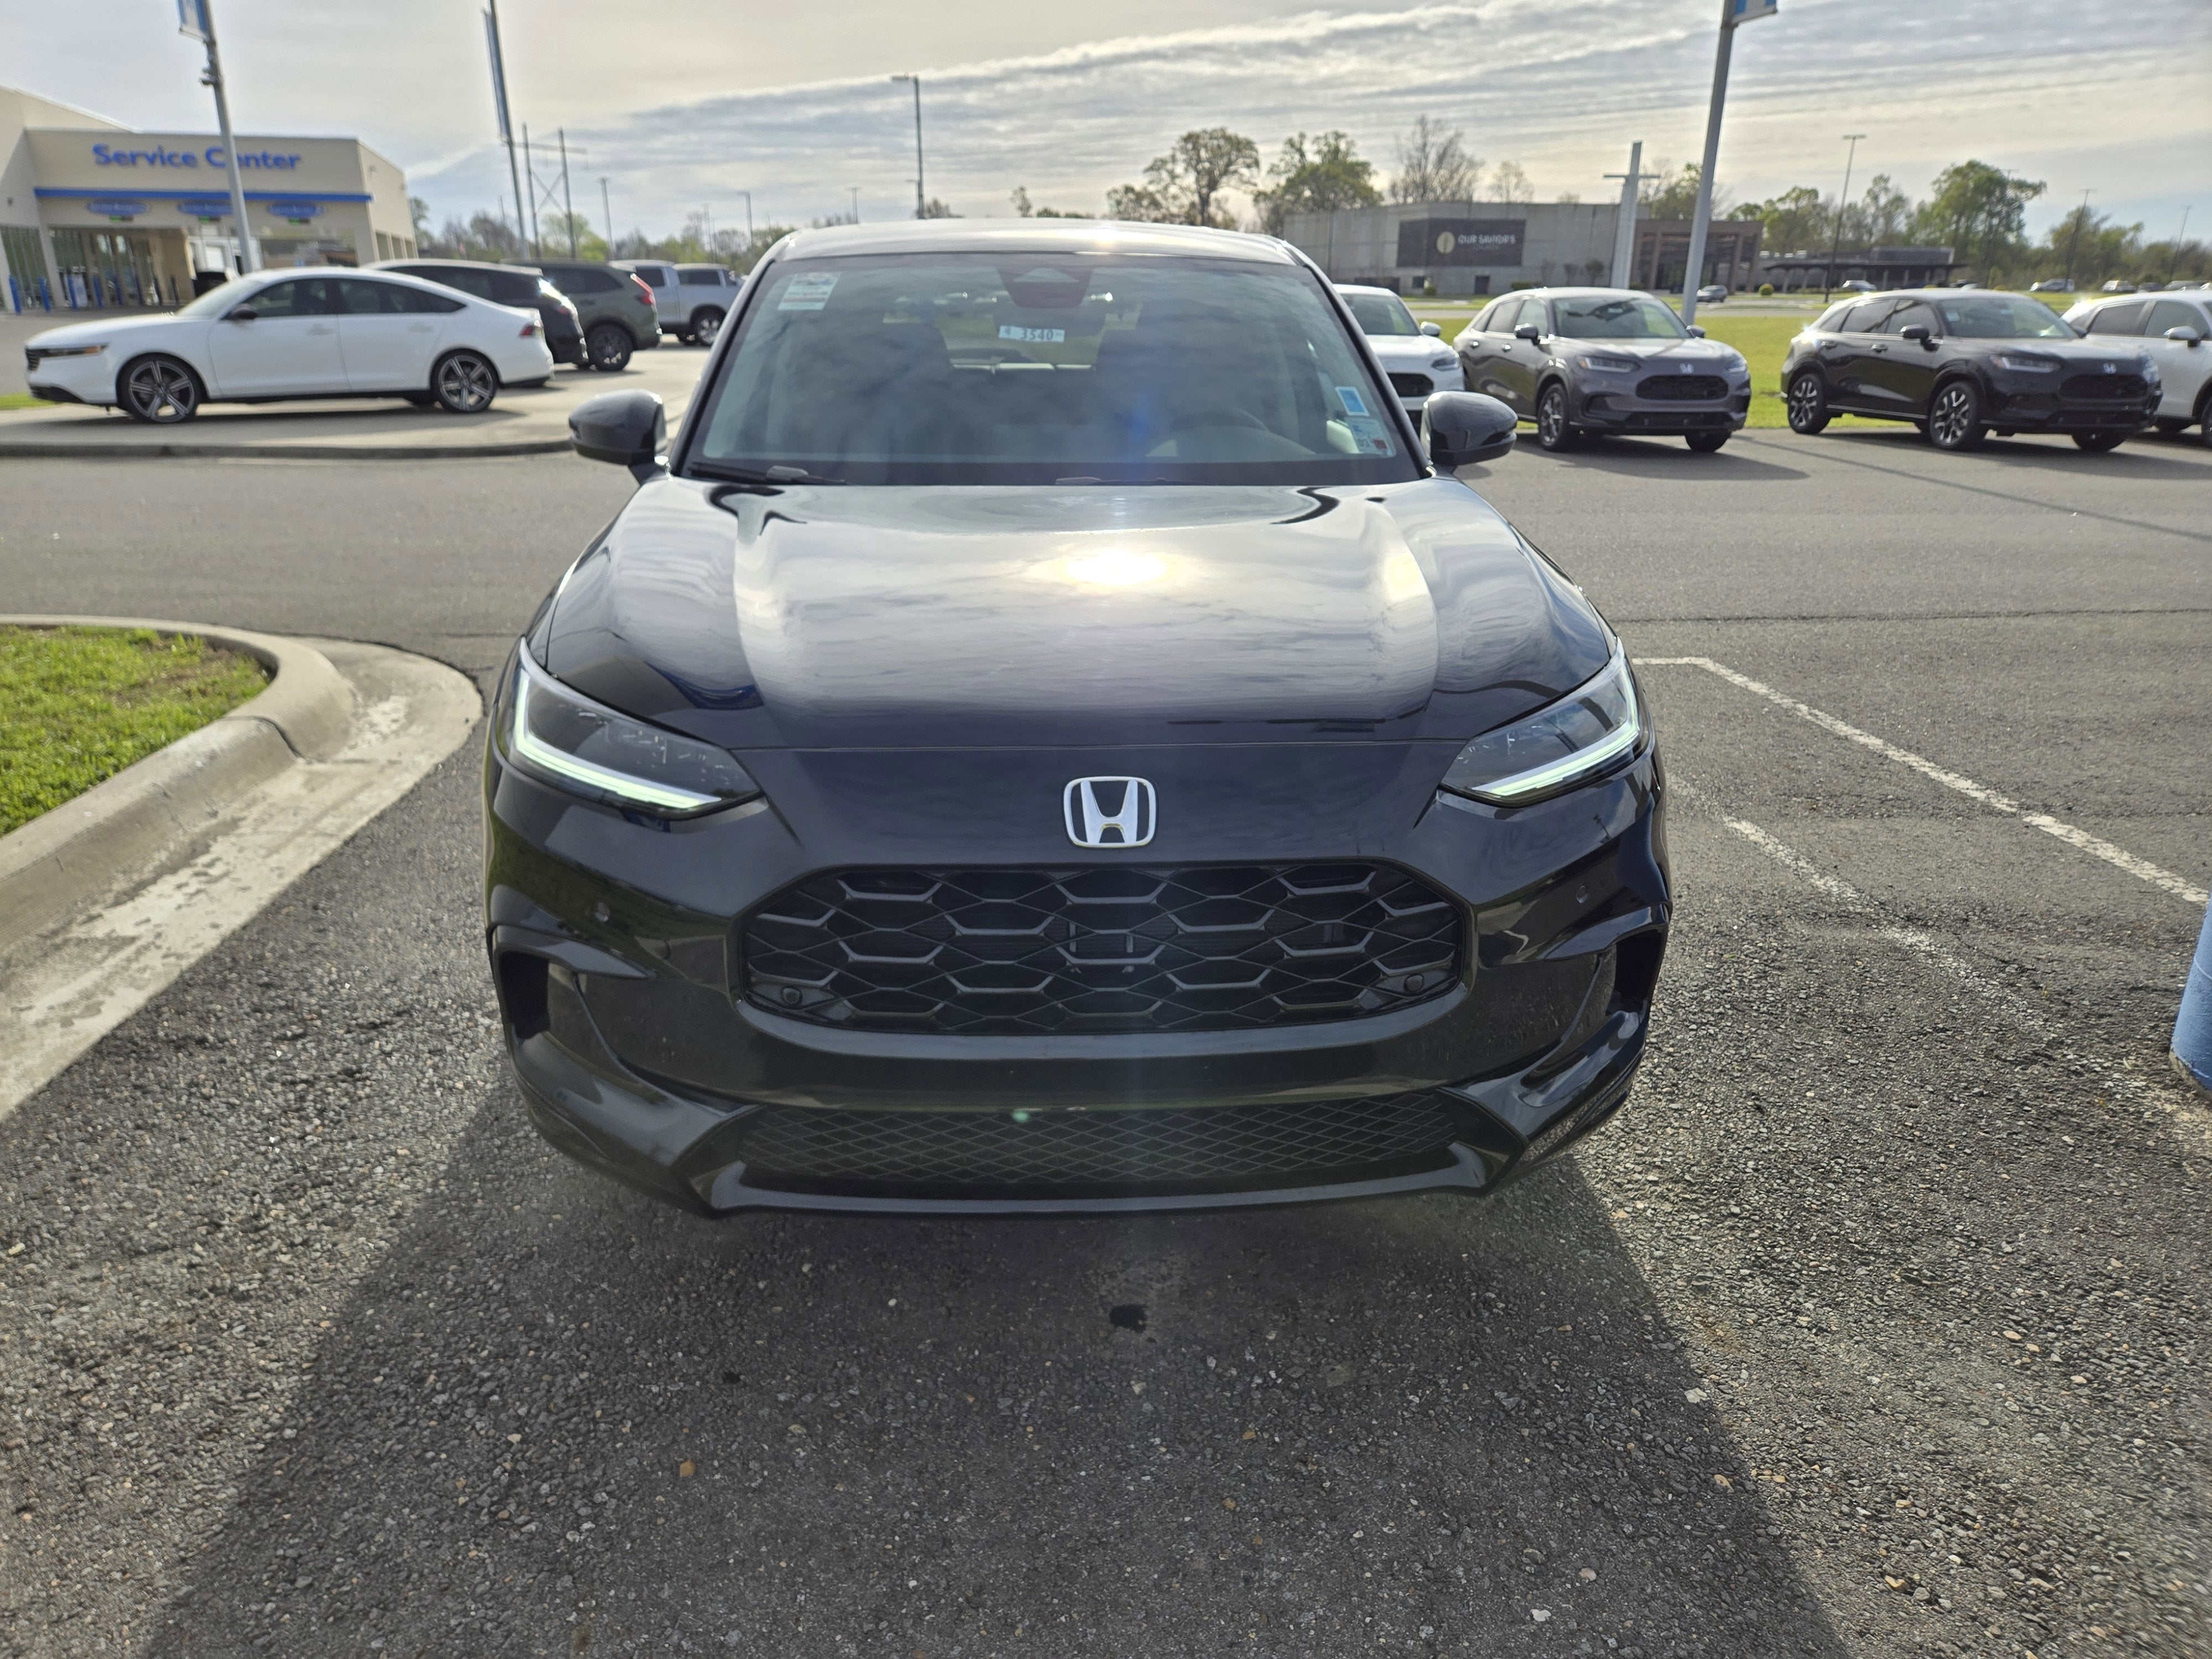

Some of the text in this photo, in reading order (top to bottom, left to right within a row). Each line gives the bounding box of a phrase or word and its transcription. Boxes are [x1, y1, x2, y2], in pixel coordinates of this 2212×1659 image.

[92, 143, 197, 167] Service
[1458, 234, 1477, 244] OUR
[1021, 328, 1053, 341] 3540
